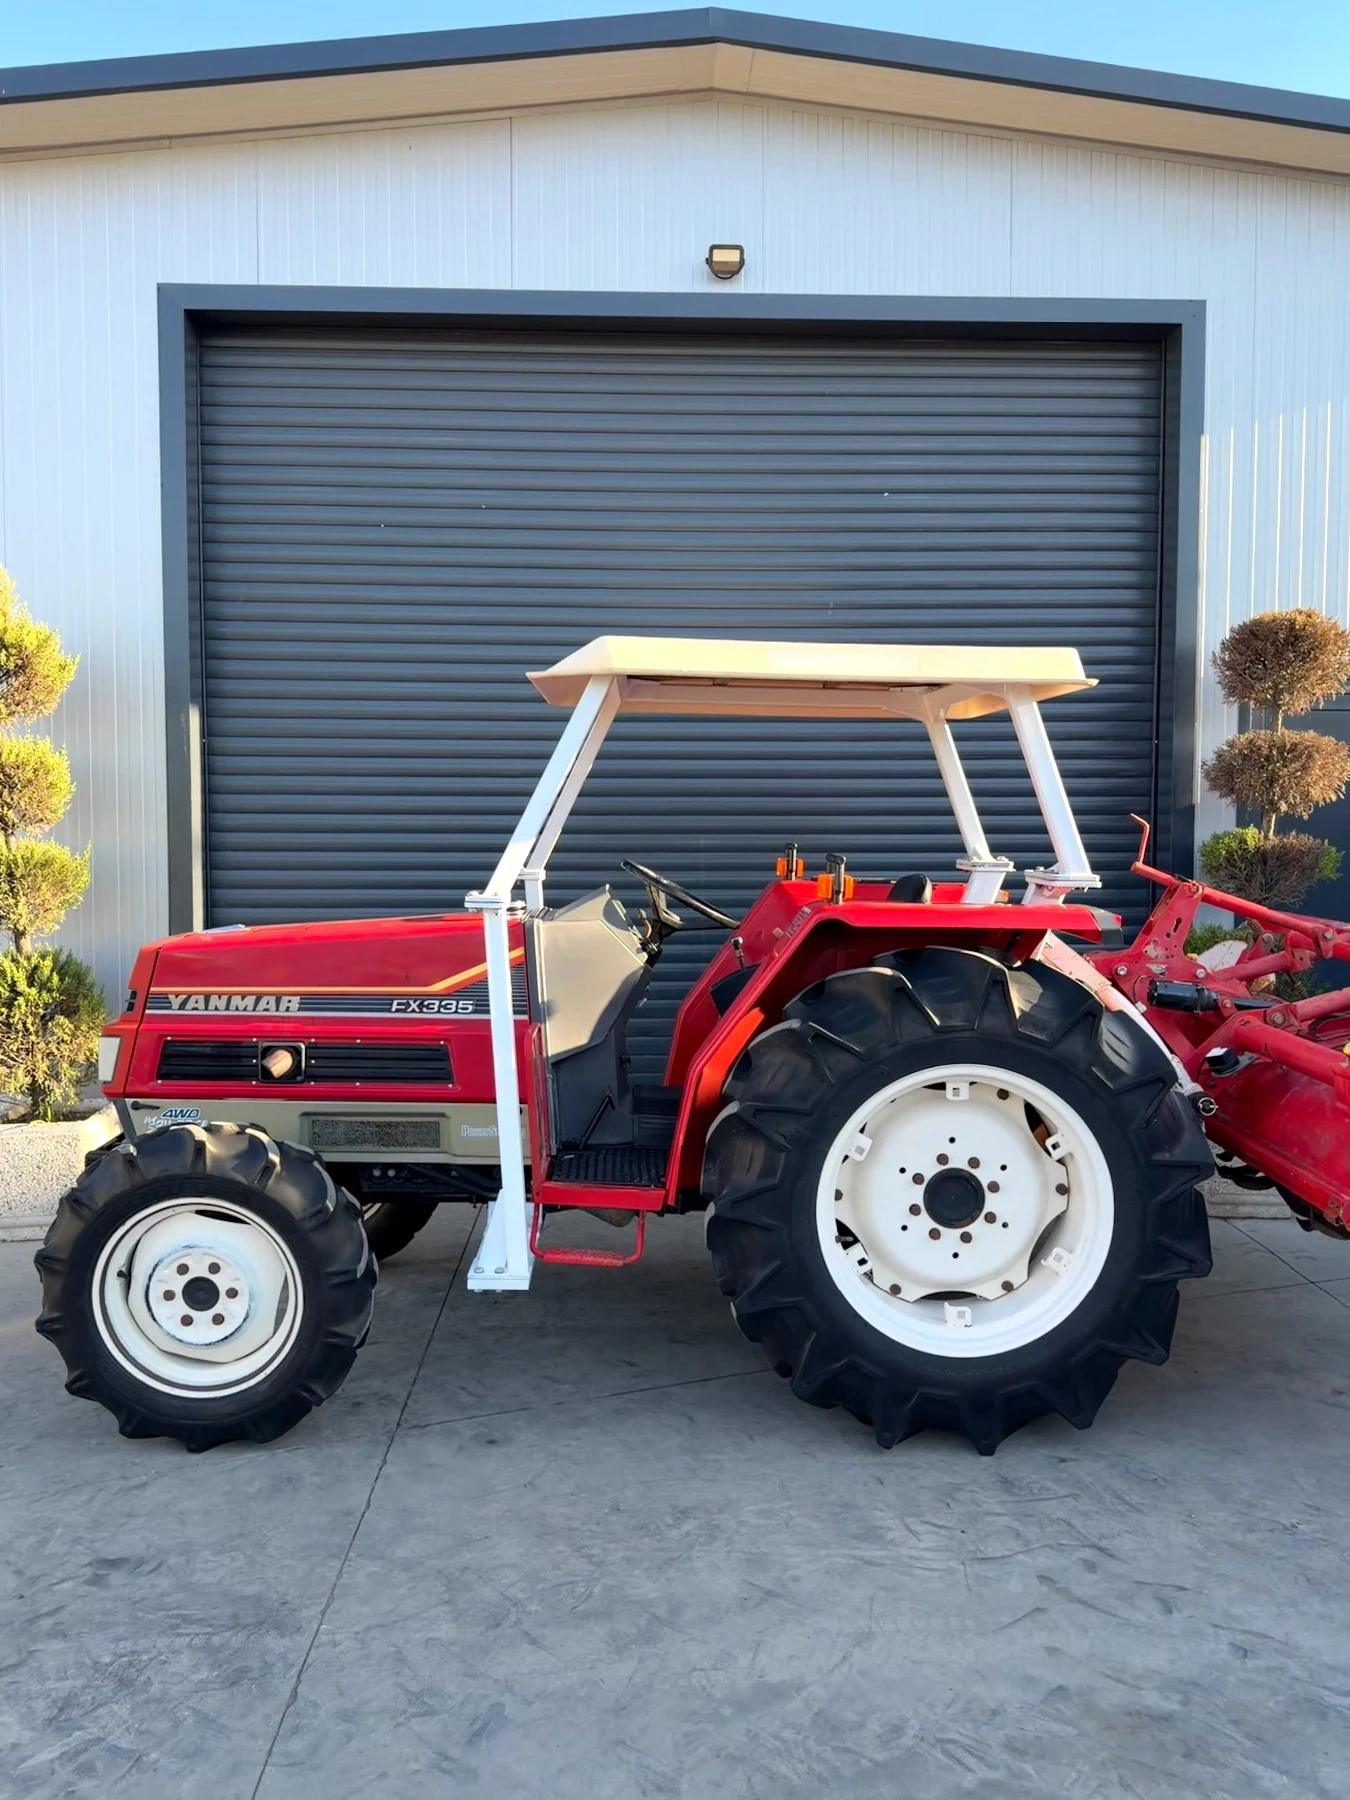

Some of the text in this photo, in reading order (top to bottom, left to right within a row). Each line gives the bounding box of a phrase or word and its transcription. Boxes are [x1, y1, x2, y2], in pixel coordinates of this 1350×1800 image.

[167, 994, 301, 1012] YANMAR
[391, 999, 474, 1013] FX335
[161, 1108, 201, 1119] 4WD
